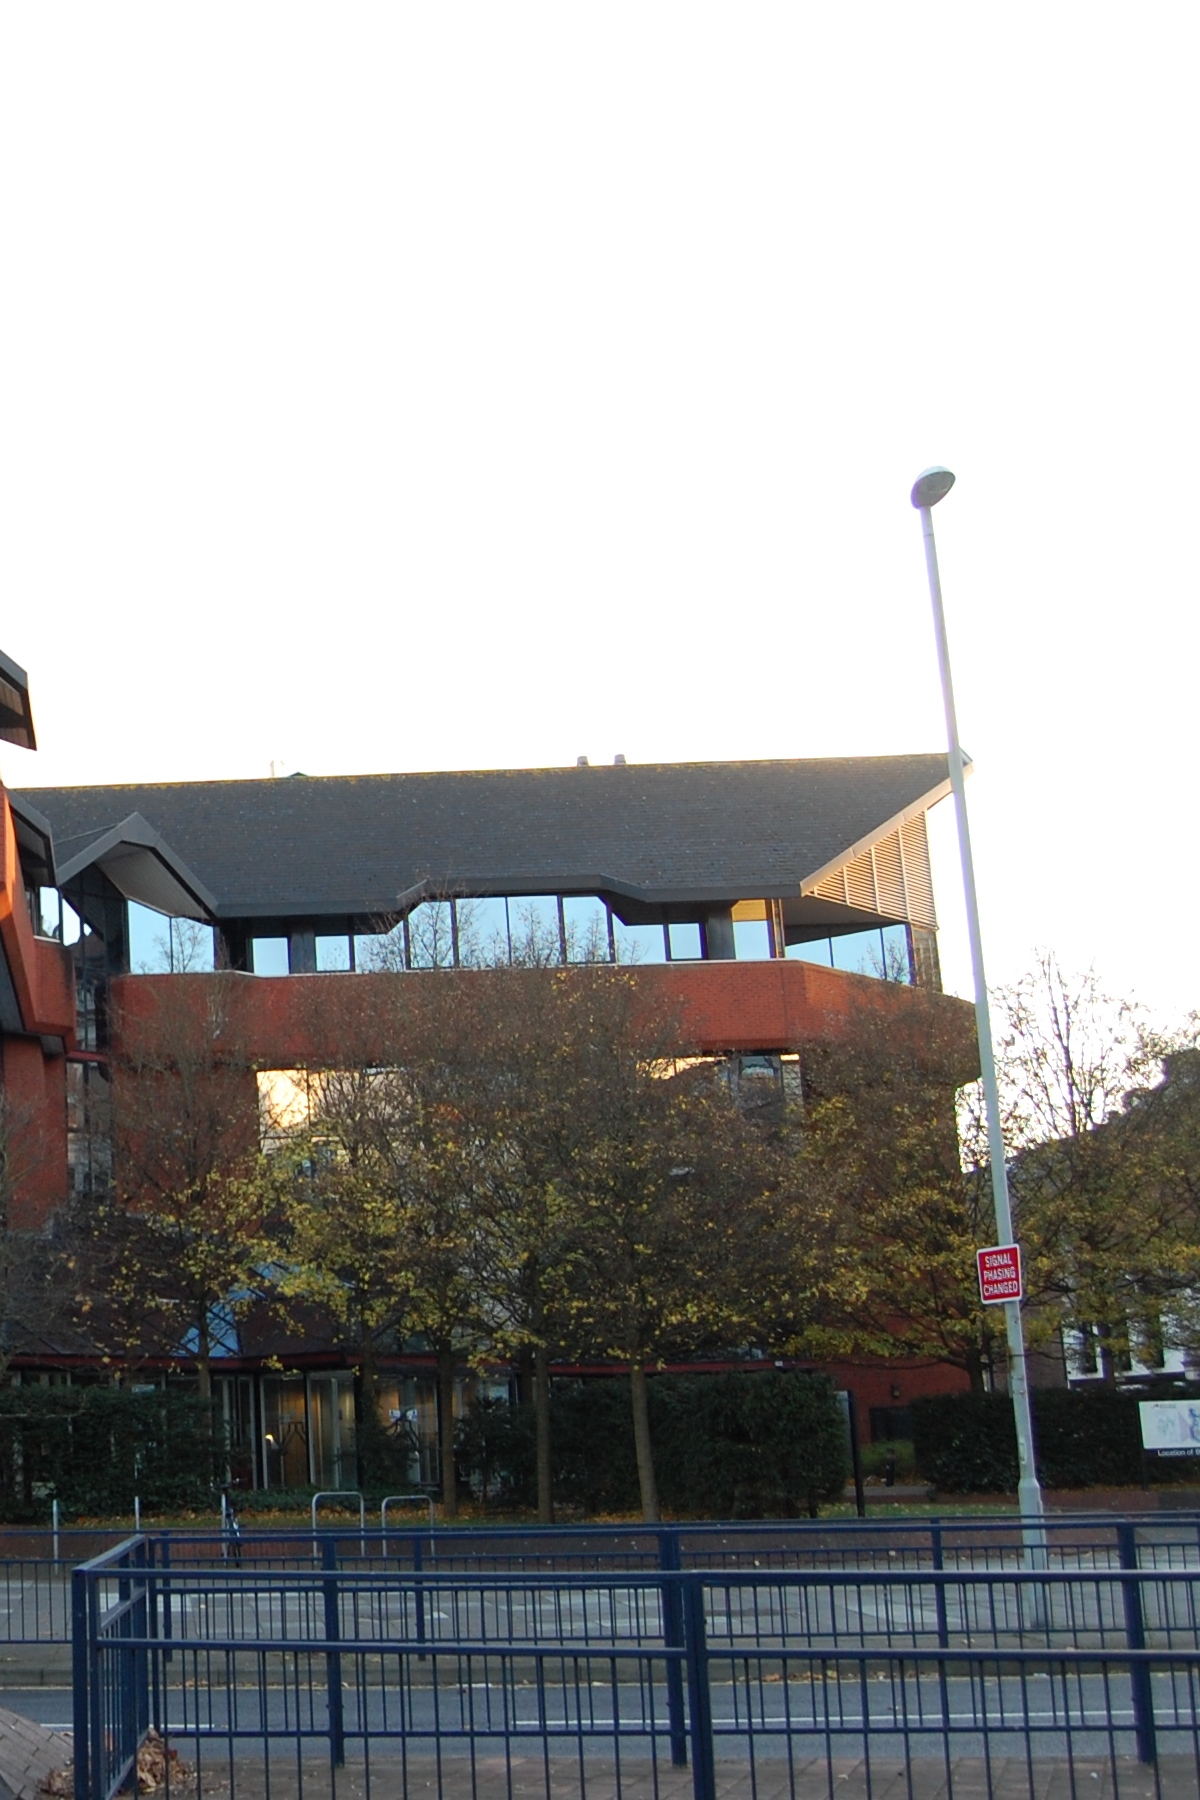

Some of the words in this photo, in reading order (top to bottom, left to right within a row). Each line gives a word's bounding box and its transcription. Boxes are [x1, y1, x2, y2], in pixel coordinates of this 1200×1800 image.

[984, 1253, 1013, 1268] SIGNAL
[983, 1266, 1016, 1282] PHASING
[983, 1280, 1018, 1296] CHANGED
